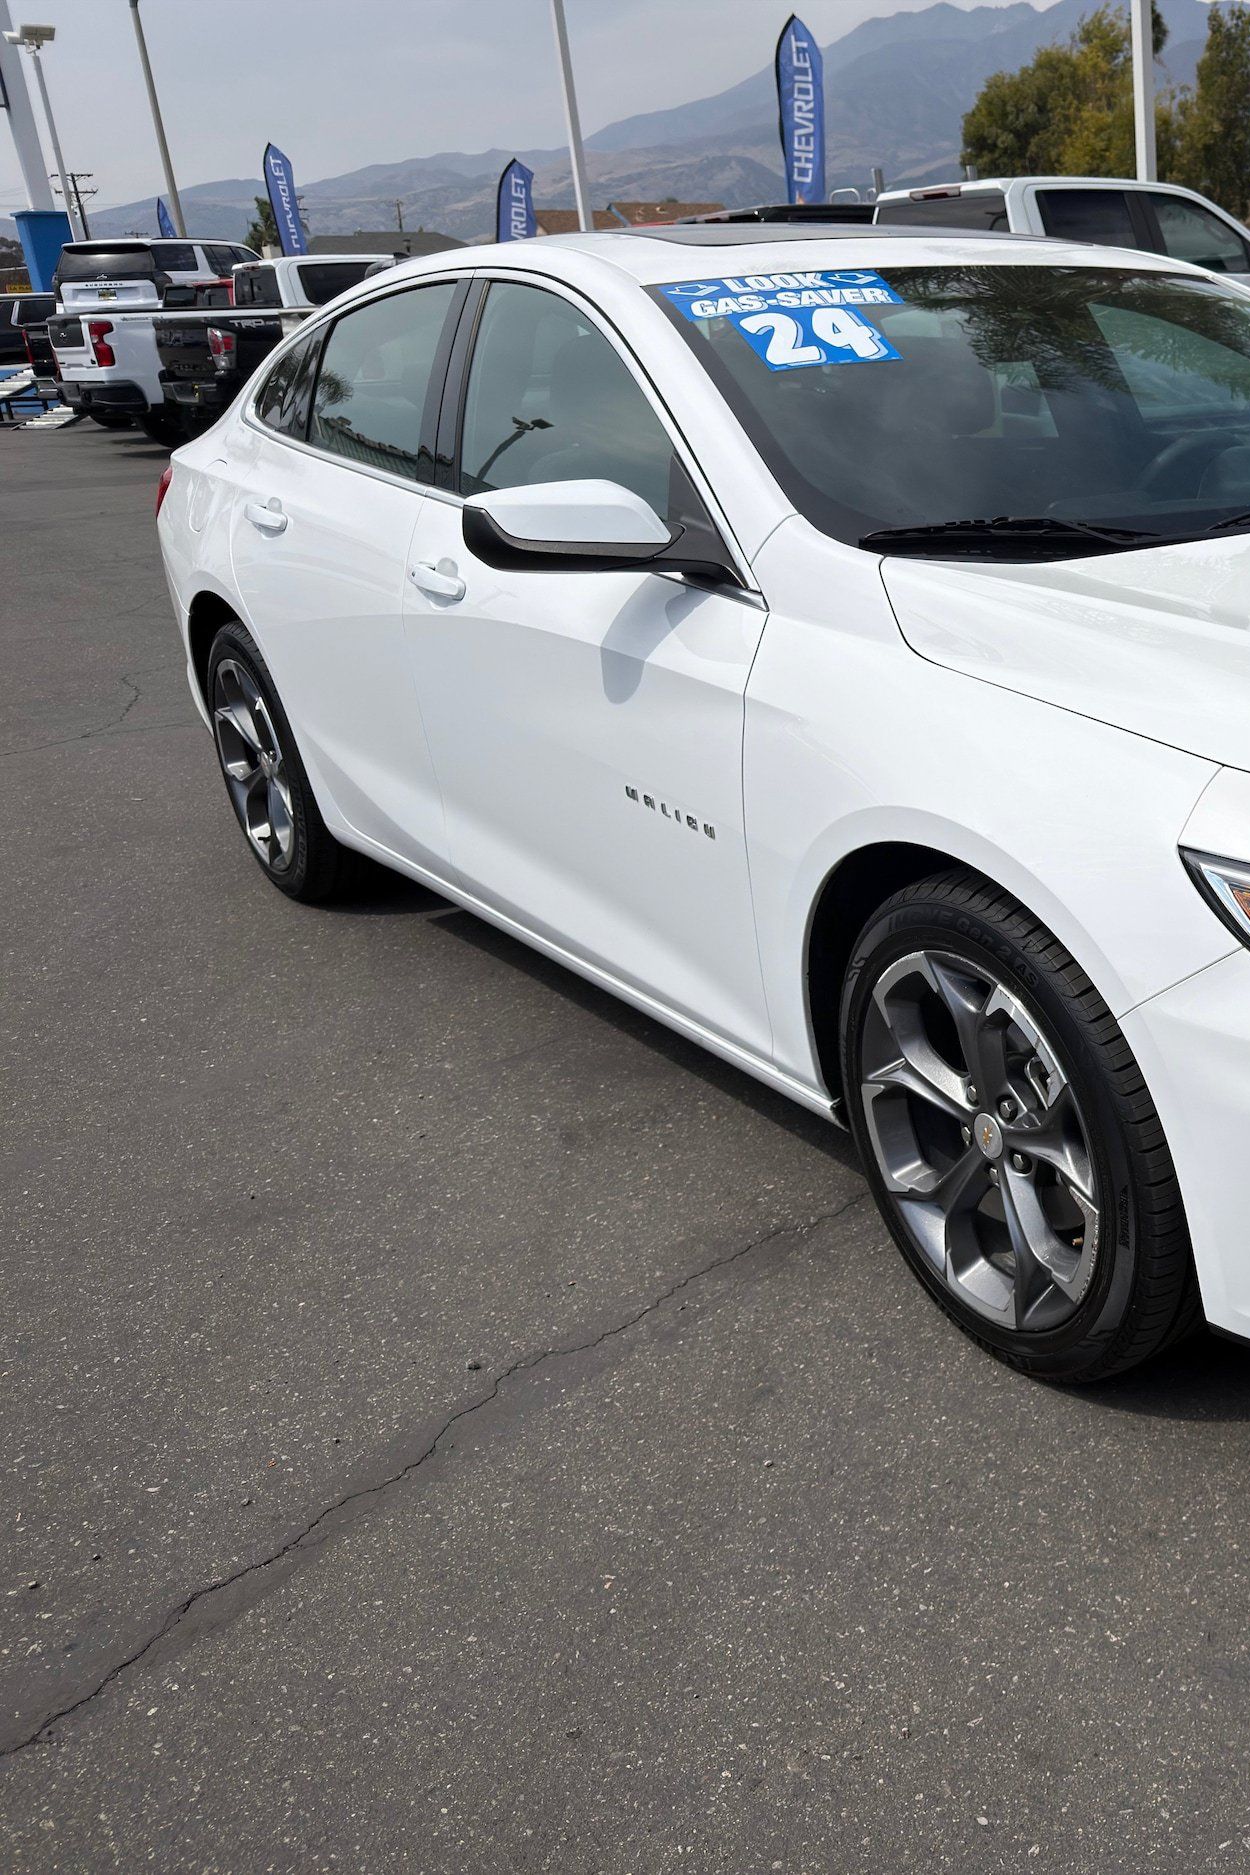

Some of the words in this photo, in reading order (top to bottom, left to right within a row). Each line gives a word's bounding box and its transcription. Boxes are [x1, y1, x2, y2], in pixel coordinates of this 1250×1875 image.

[791, 34, 814, 183] CHEVROLET
[690, 287, 894, 317] GAS-SAVER
[721, 272, 834, 293] LOOK
[229, 318, 265, 328] TRD
[739, 307, 888, 367] 24
[625, 785, 716, 840] MALIBU
